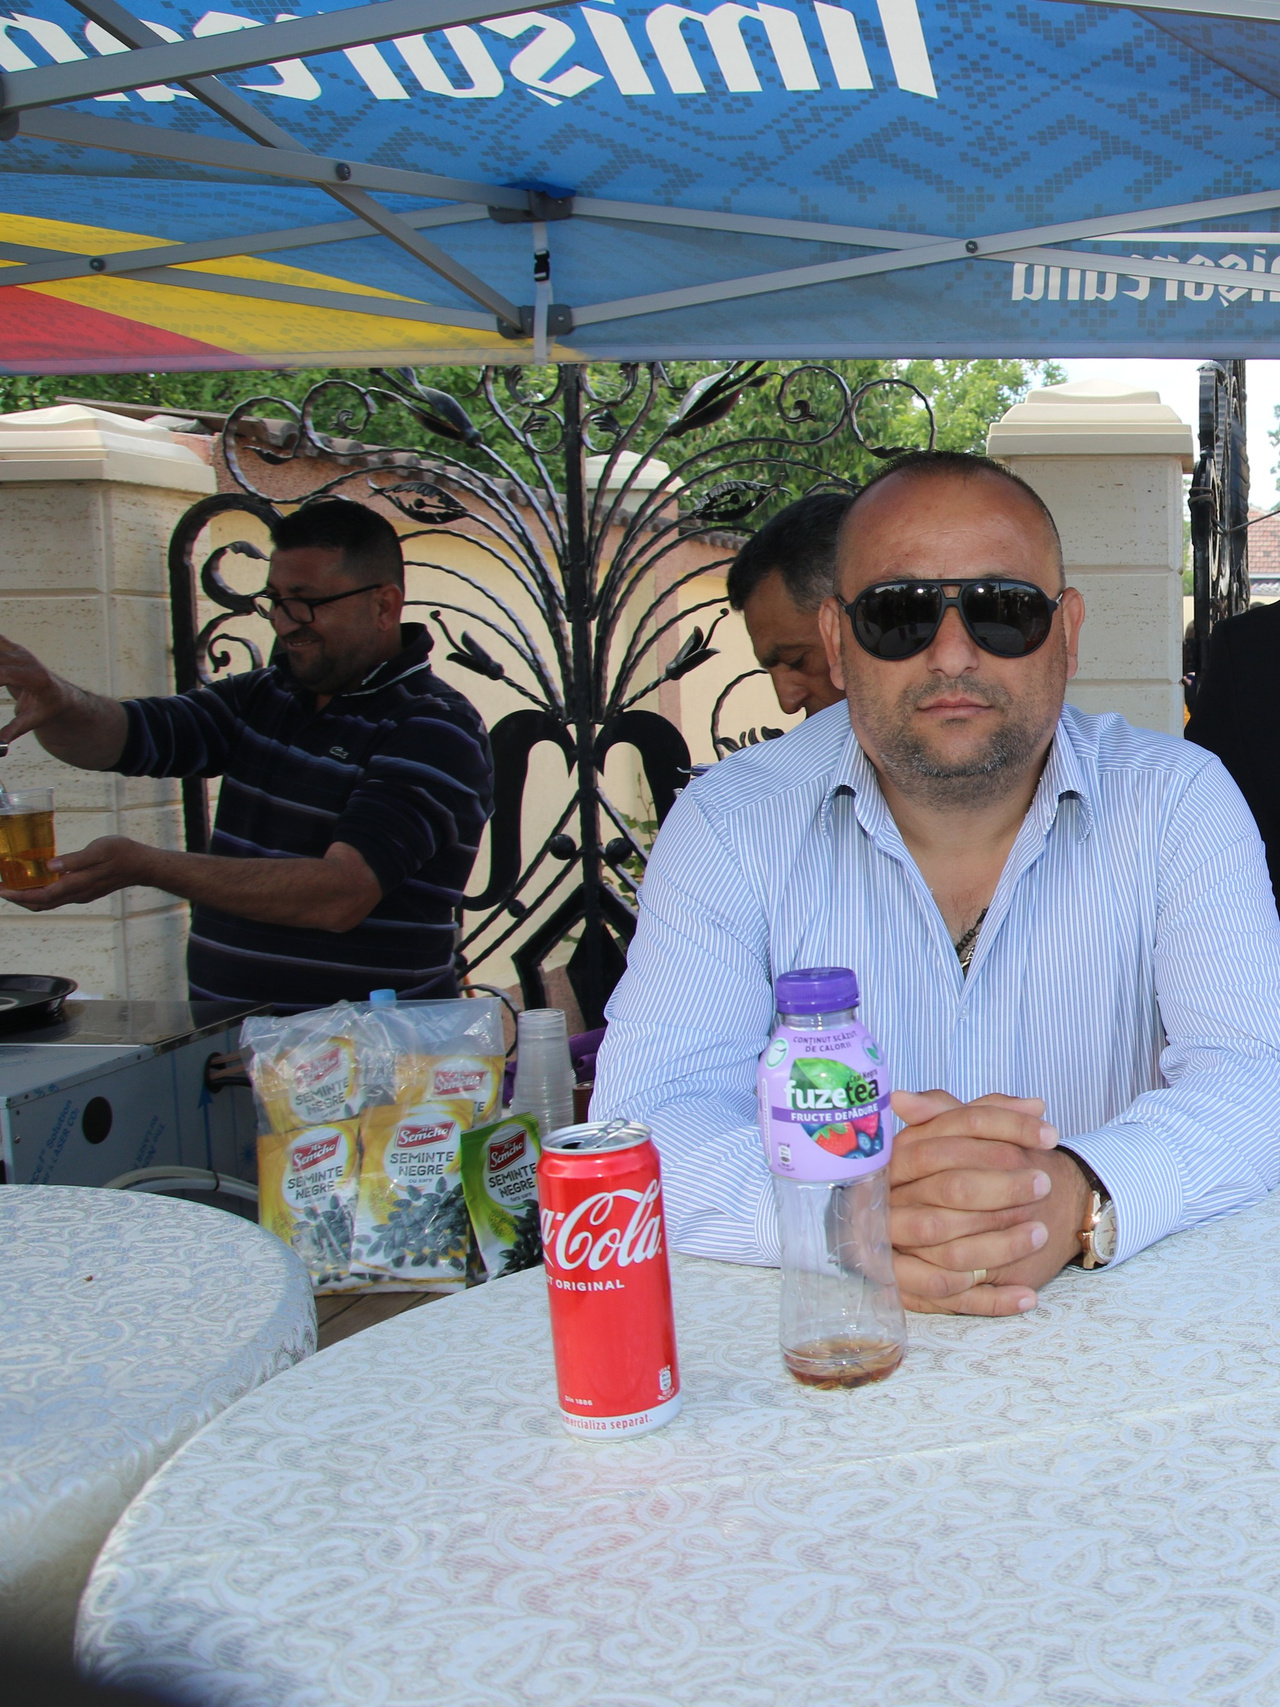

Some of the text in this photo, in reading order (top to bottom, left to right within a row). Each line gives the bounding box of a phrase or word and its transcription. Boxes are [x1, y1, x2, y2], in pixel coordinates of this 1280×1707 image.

[820, 1042, 852, 1053] CALORII
[790, 1112, 832, 1122] FRUCTE
[389, 1151, 455, 1164] SEMINTE
[287, 1165, 344, 1190] SEMINTE
[398, 1164, 444, 1177] NEGRE
[488, 1162, 537, 1188] SEMINTE
[295, 1180, 336, 1200] NEGRE
[498, 1177, 536, 1199] NEGRE
[555, 1278, 626, 1292] ORIGINAL
